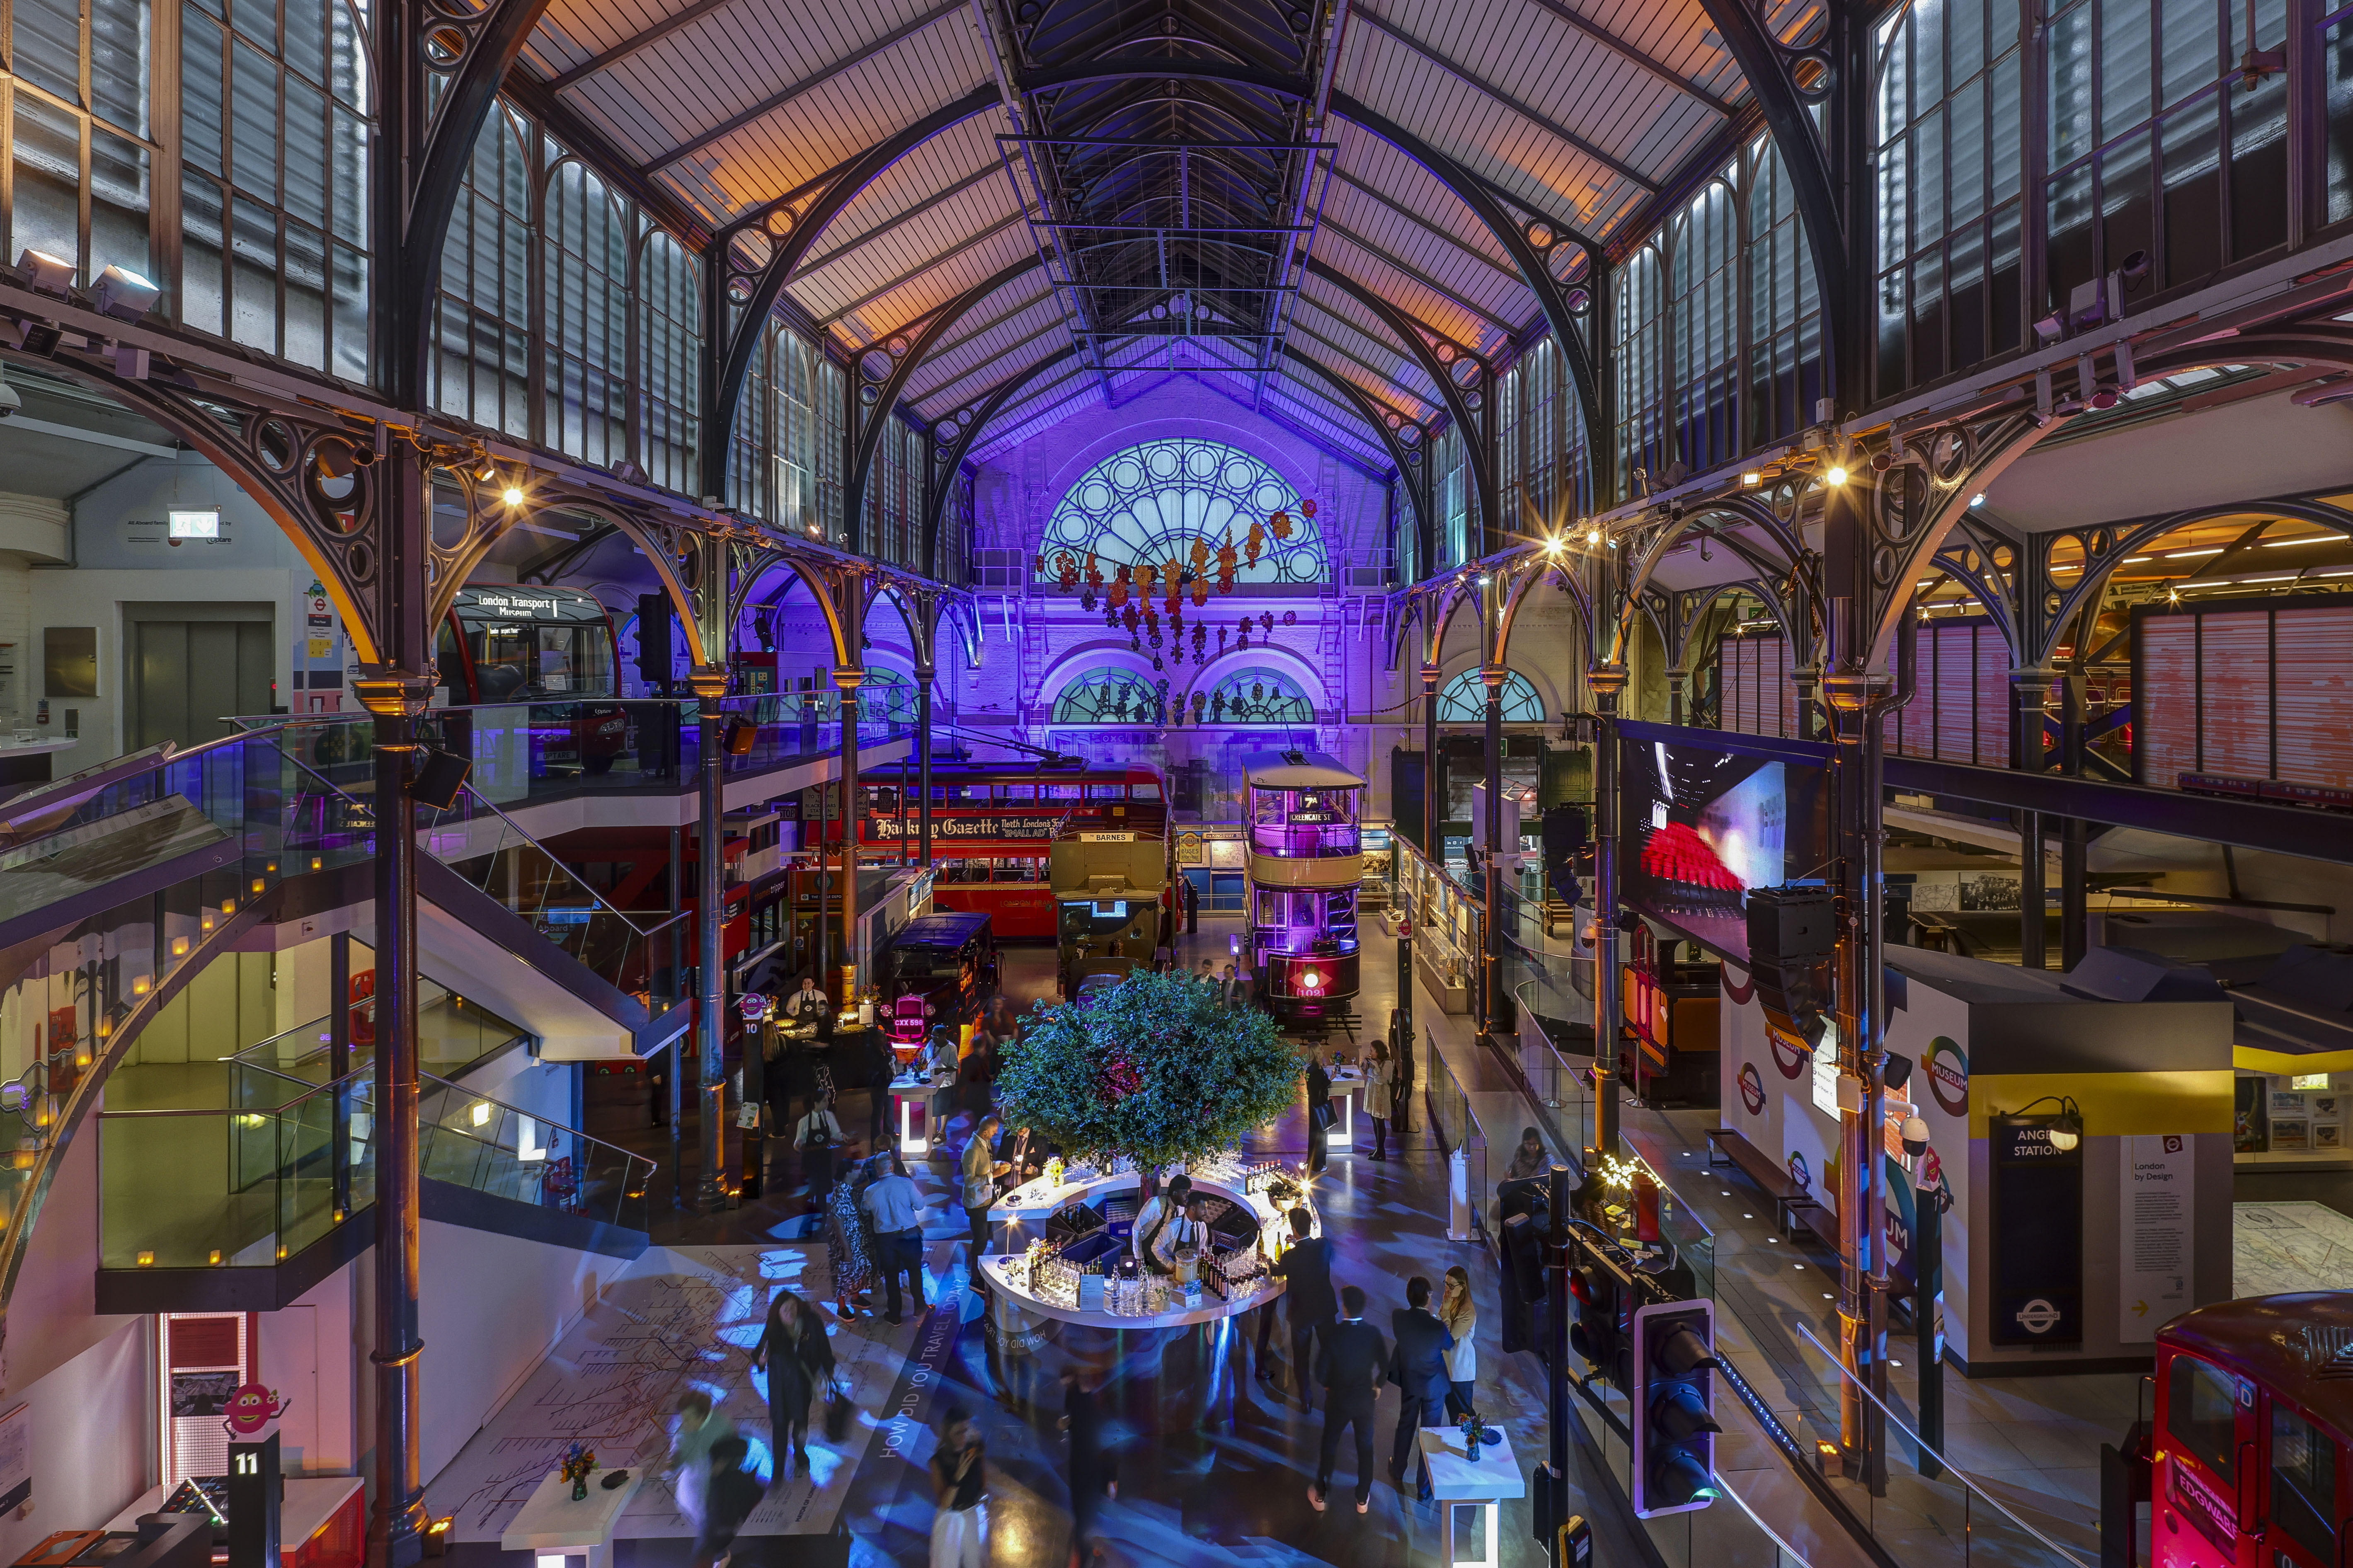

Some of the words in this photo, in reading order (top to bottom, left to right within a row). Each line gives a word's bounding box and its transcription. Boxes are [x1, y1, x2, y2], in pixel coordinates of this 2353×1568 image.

[479, 595, 509, 606] London
[511, 596, 550, 610] Transport
[499, 607, 531, 617] Museum
[880, 796, 892, 806] STOP
[1304, 797, 1318, 808] 7A
[780, 809, 794, 818] STOP
[876, 818, 939, 840] Hakny
[942, 818, 999, 835] Gazette
[1001, 819, 1020, 828] North
[1022, 818, 1051, 828] London's
[1480, 915, 1484, 924] On
[1405, 942, 1409, 950] 9
[745, 1023, 757, 1034] 10
[1931, 1062, 1968, 1091] MUSEUM
[1742, 1079, 1761, 1099] MUSEUM
[2018, 1130, 2051, 1140] ANGE
[2014, 1146, 2062, 1156] STATION
[1792, 1163, 1807, 1180] MUSEUM
[2135, 1173, 2144, 1181] by
[2147, 1173, 2173, 1181] Design
[939, 1278, 967, 1318] TODAY?
[921, 1318, 951, 1360] TRAVEL
[908, 1362, 933, 1391] YOU
[901, 1393, 920, 1418] DID
[2241, 1387, 2253, 1408] D
[879, 1420, 909, 1458] HOW
[235, 1452, 258, 1475] 11
[2179, 1474, 2237, 1539] EDGWARE
